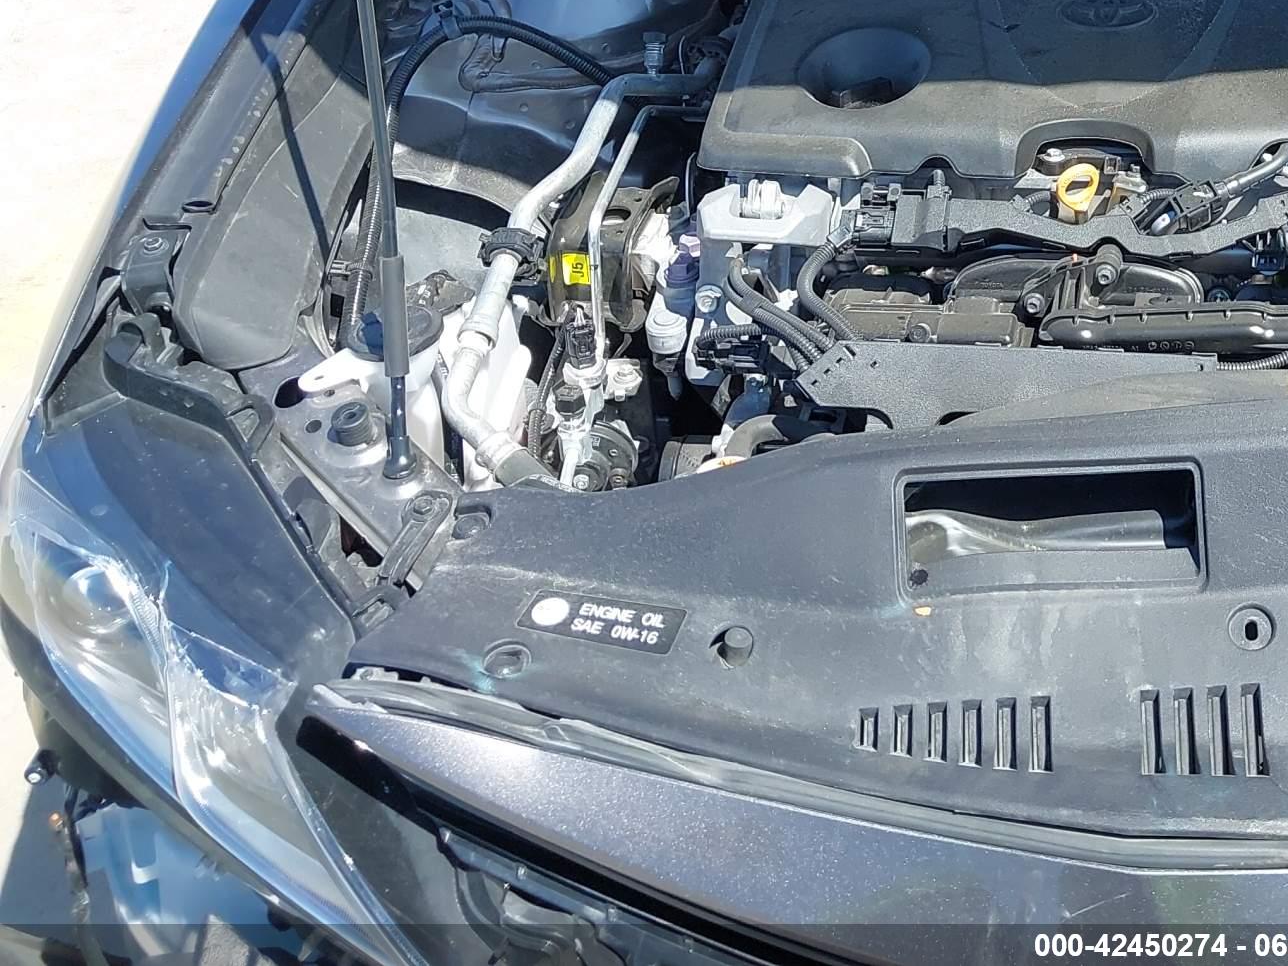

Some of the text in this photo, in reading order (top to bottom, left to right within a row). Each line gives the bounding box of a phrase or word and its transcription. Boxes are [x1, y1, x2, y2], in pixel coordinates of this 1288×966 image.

[571, 262, 585, 278] J5
[578, 602, 667, 629] ENGINE OIL
[570, 617, 660, 645] SAE 0W-16
